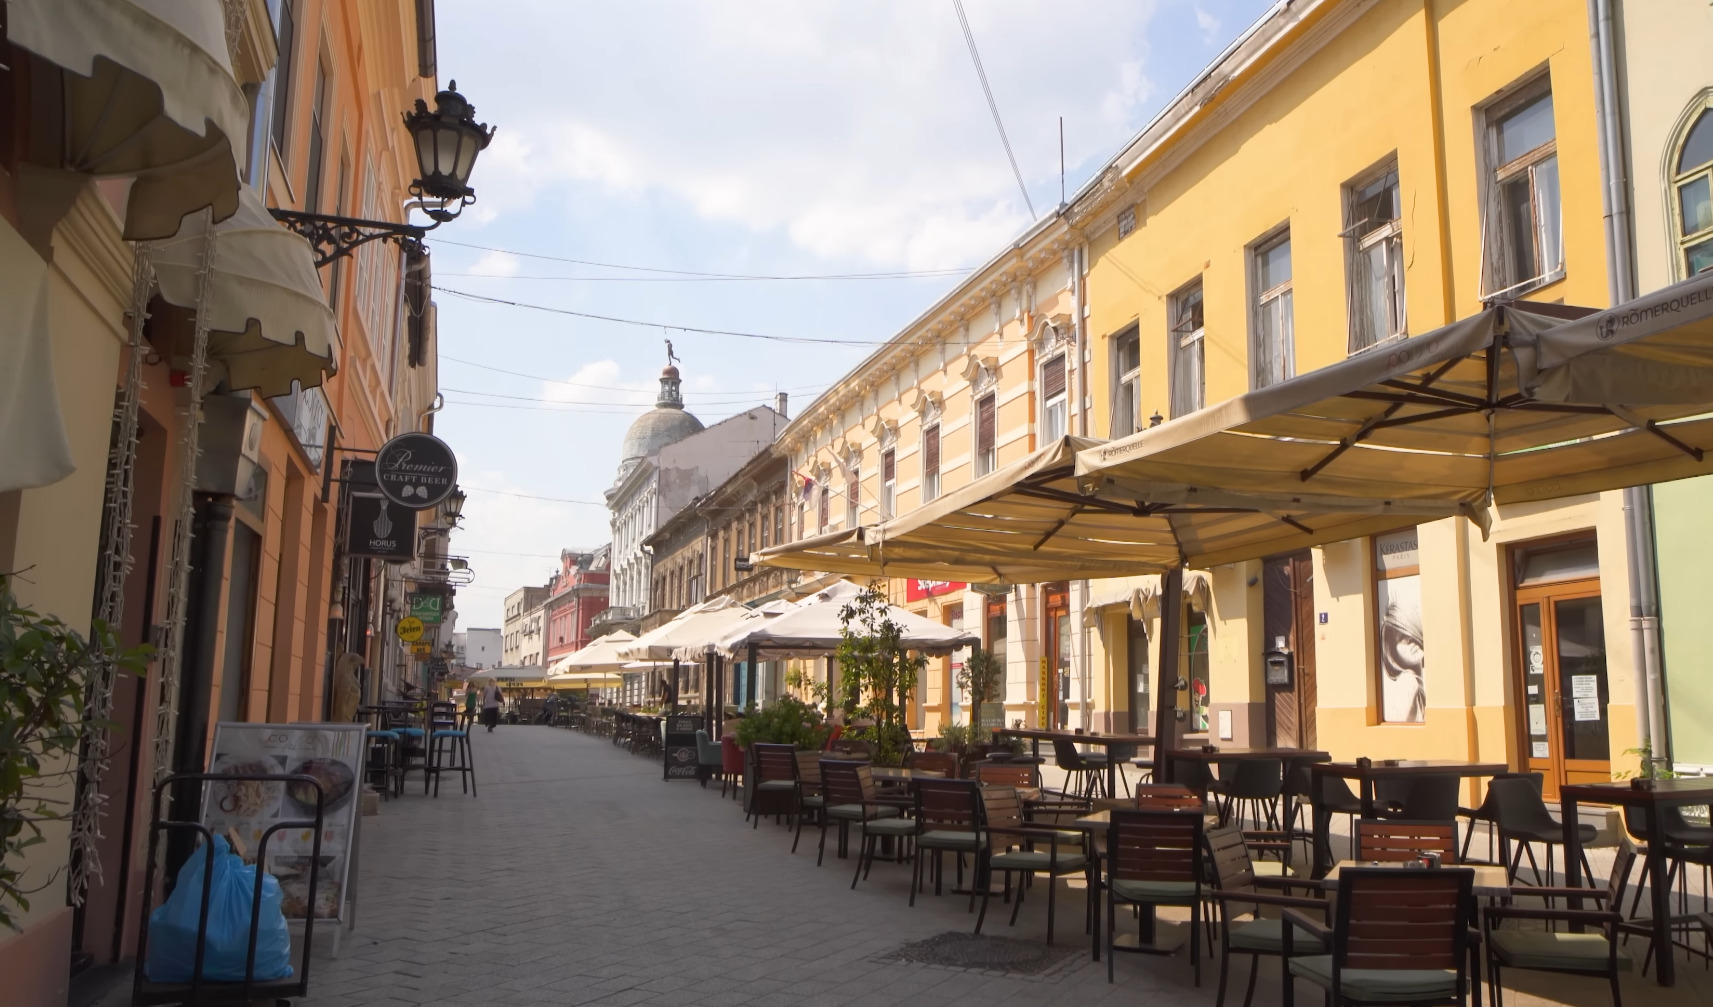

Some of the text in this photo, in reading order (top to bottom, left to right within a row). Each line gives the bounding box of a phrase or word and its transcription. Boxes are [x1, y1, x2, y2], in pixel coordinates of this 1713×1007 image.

[382, 445, 451, 473] Premier
[383, 473, 448, 485] CRAFT BEER
[369, 539, 397, 548] HORUS
